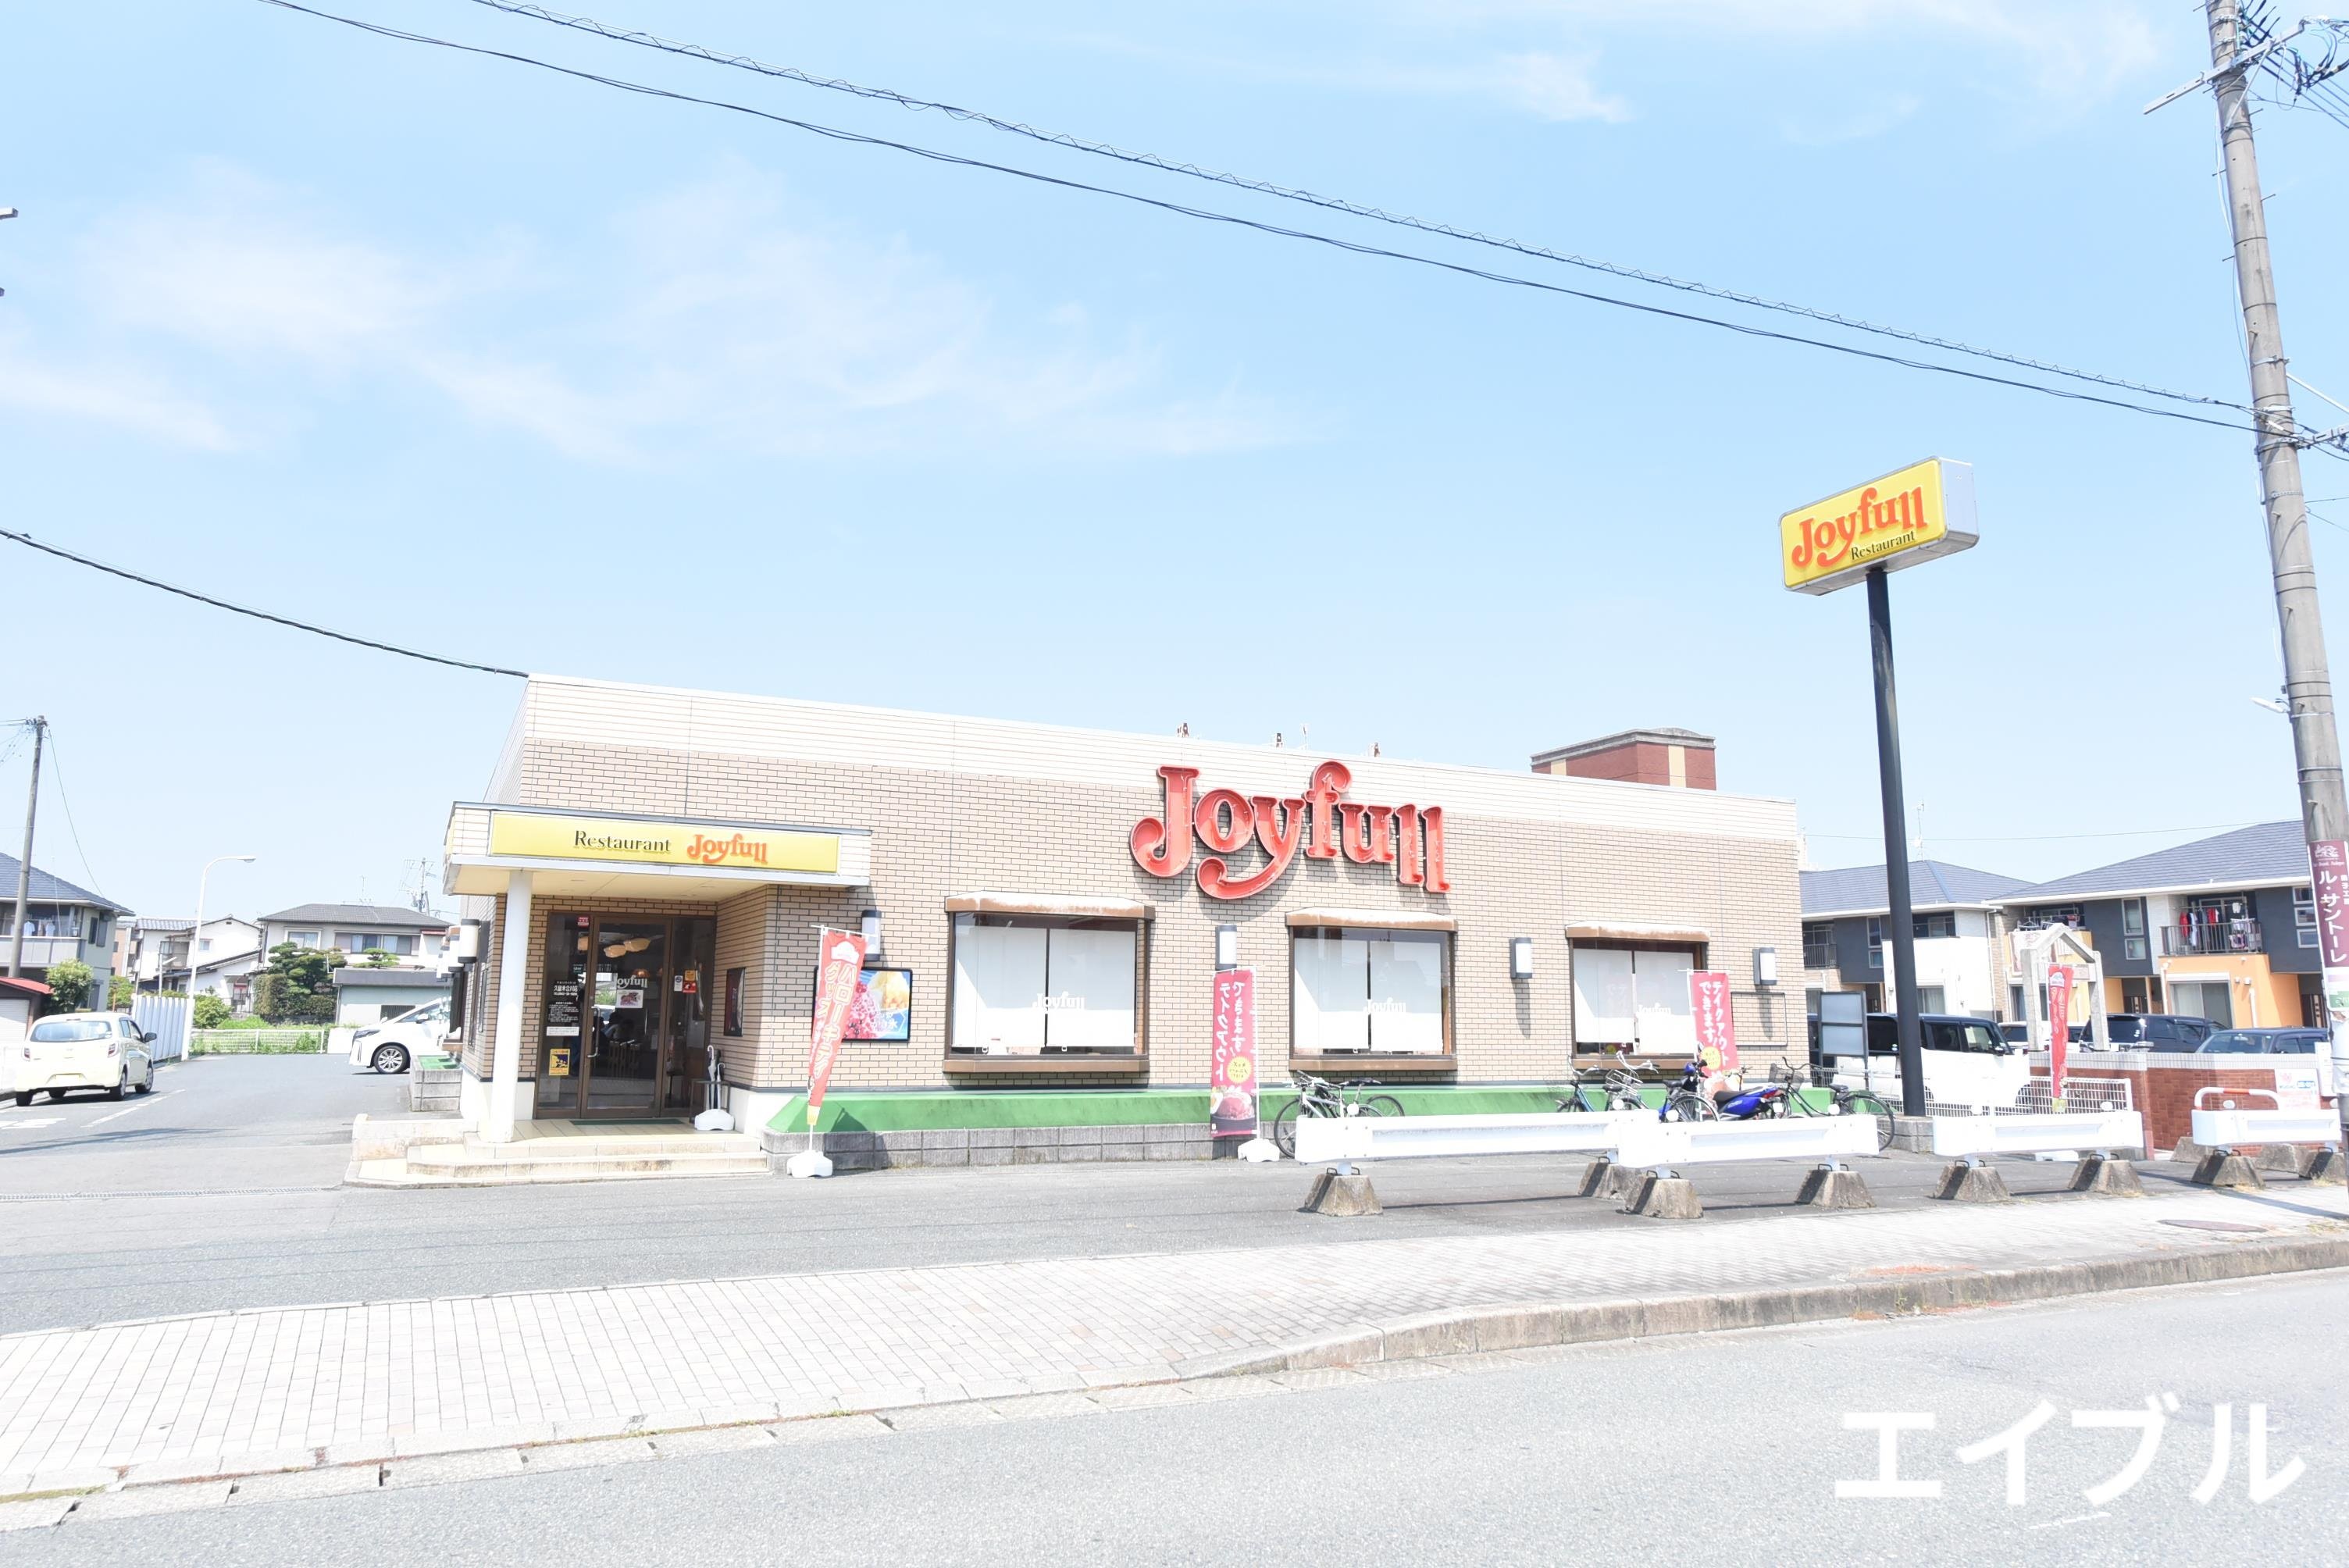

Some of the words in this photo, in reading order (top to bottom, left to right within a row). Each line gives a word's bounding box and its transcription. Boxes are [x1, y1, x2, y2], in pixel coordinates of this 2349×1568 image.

[1792, 486, 1927, 568] Joyfull
[1851, 530, 1916, 561] Restaurant
[574, 829, 672, 853] Restaurant
[686, 833, 769, 865] Joyfull
[1130, 760, 1451, 900] Joyfull
[2319, 871, 2347, 963] ル・サントーレ
[814, 964, 857, 1079] ハローキティ
[1712, 981, 1729, 1067] テイクアウト
